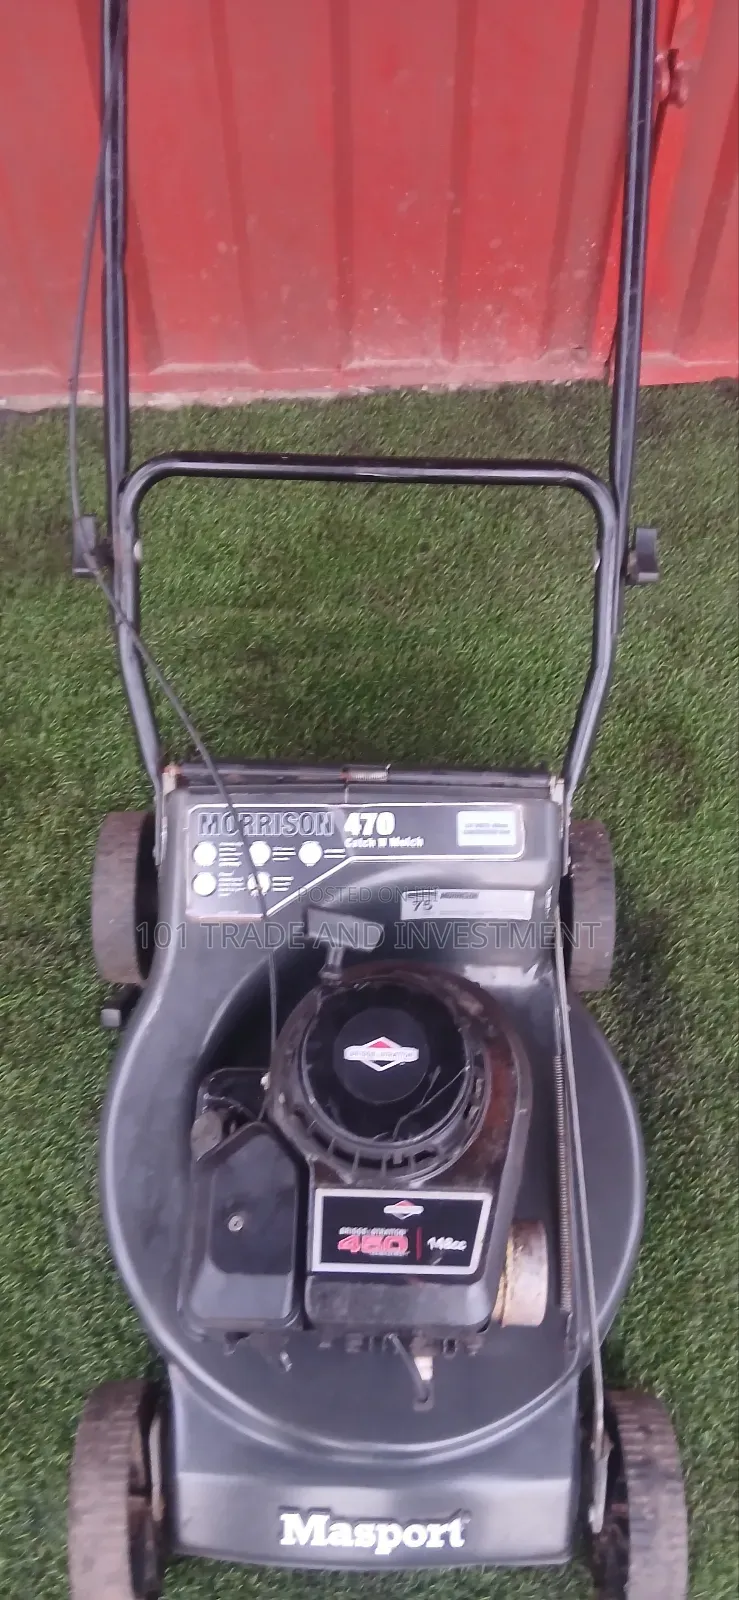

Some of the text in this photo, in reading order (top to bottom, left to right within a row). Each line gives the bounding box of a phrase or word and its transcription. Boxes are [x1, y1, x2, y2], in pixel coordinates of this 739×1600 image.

[198, 811, 396, 837] MORRISON 470
[280, 1513, 469, 1556] Masport
